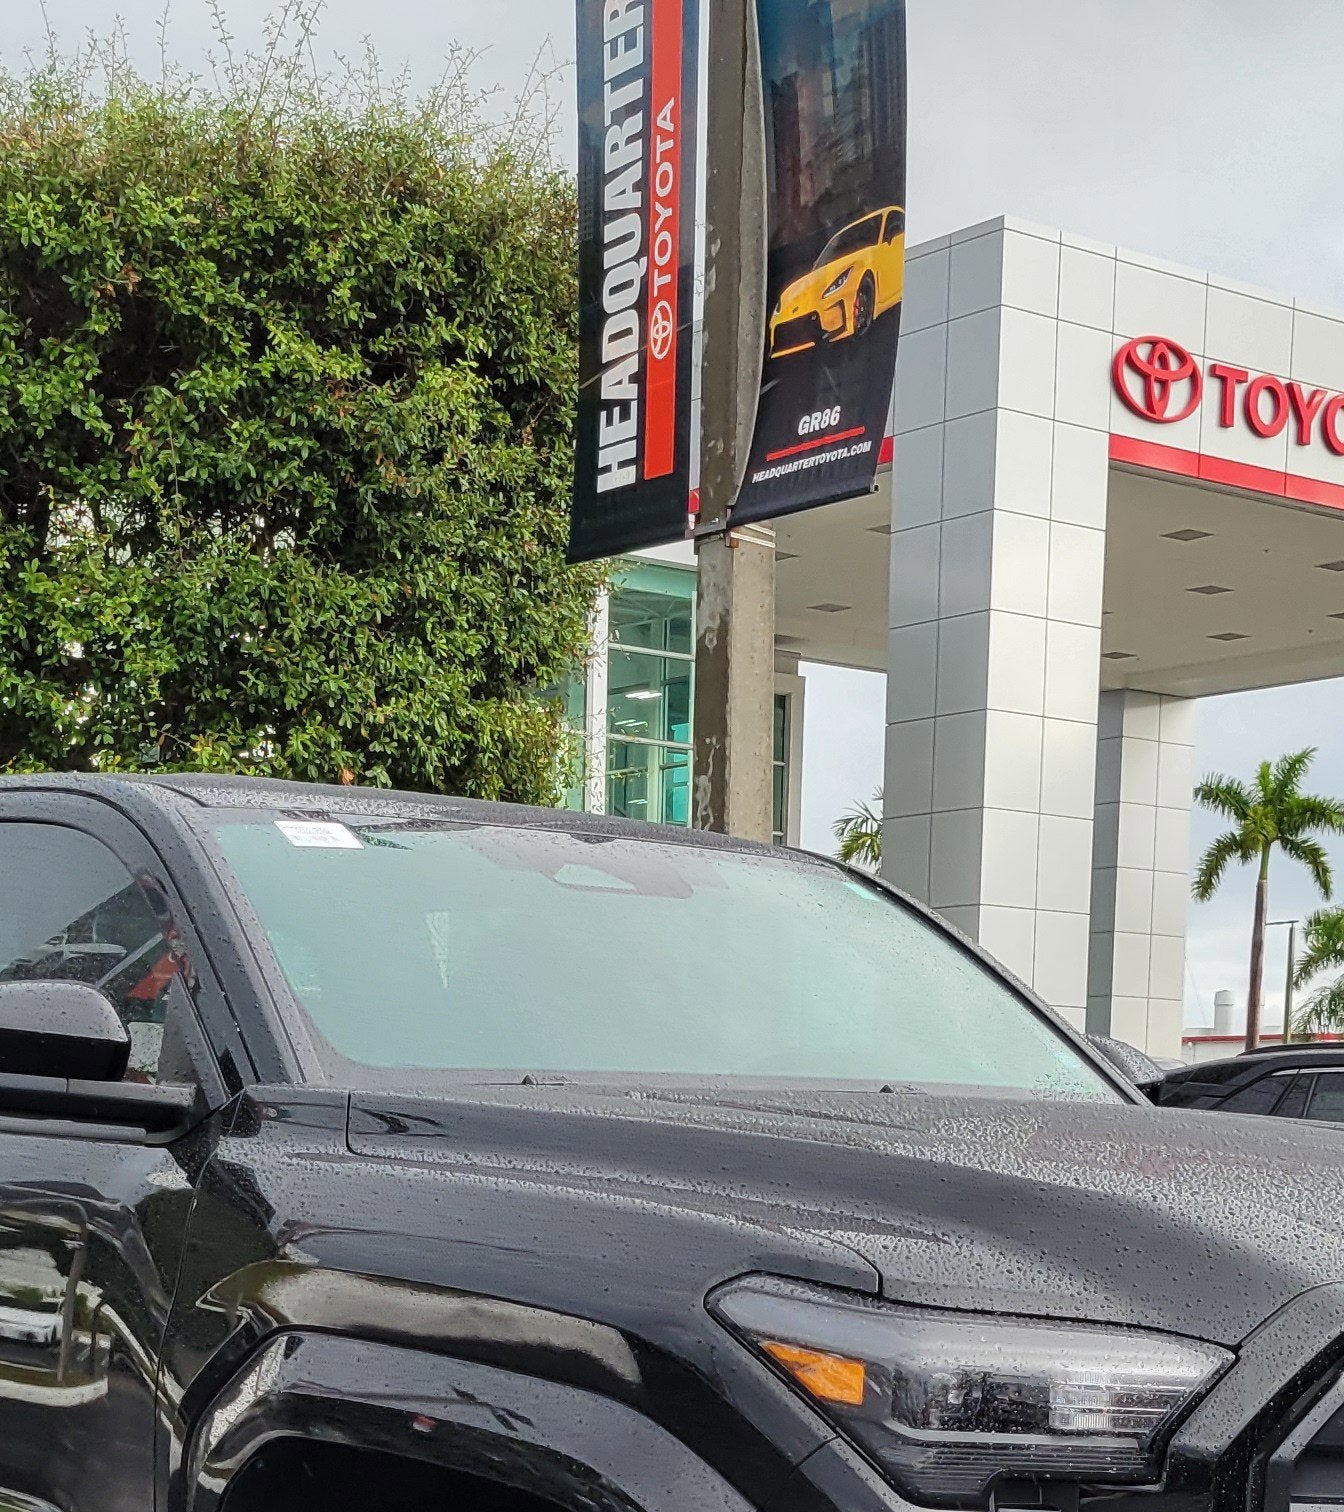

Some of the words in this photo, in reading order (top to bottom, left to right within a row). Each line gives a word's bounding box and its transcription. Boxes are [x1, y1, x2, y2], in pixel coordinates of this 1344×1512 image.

[596, 0, 647, 494] HEADQUARTER
[652, 97, 675, 297] TOYOTA
[752, 440, 872, 484] HEADQUARTERTOYOTA.COM
[797, 405, 842, 437] GR86
